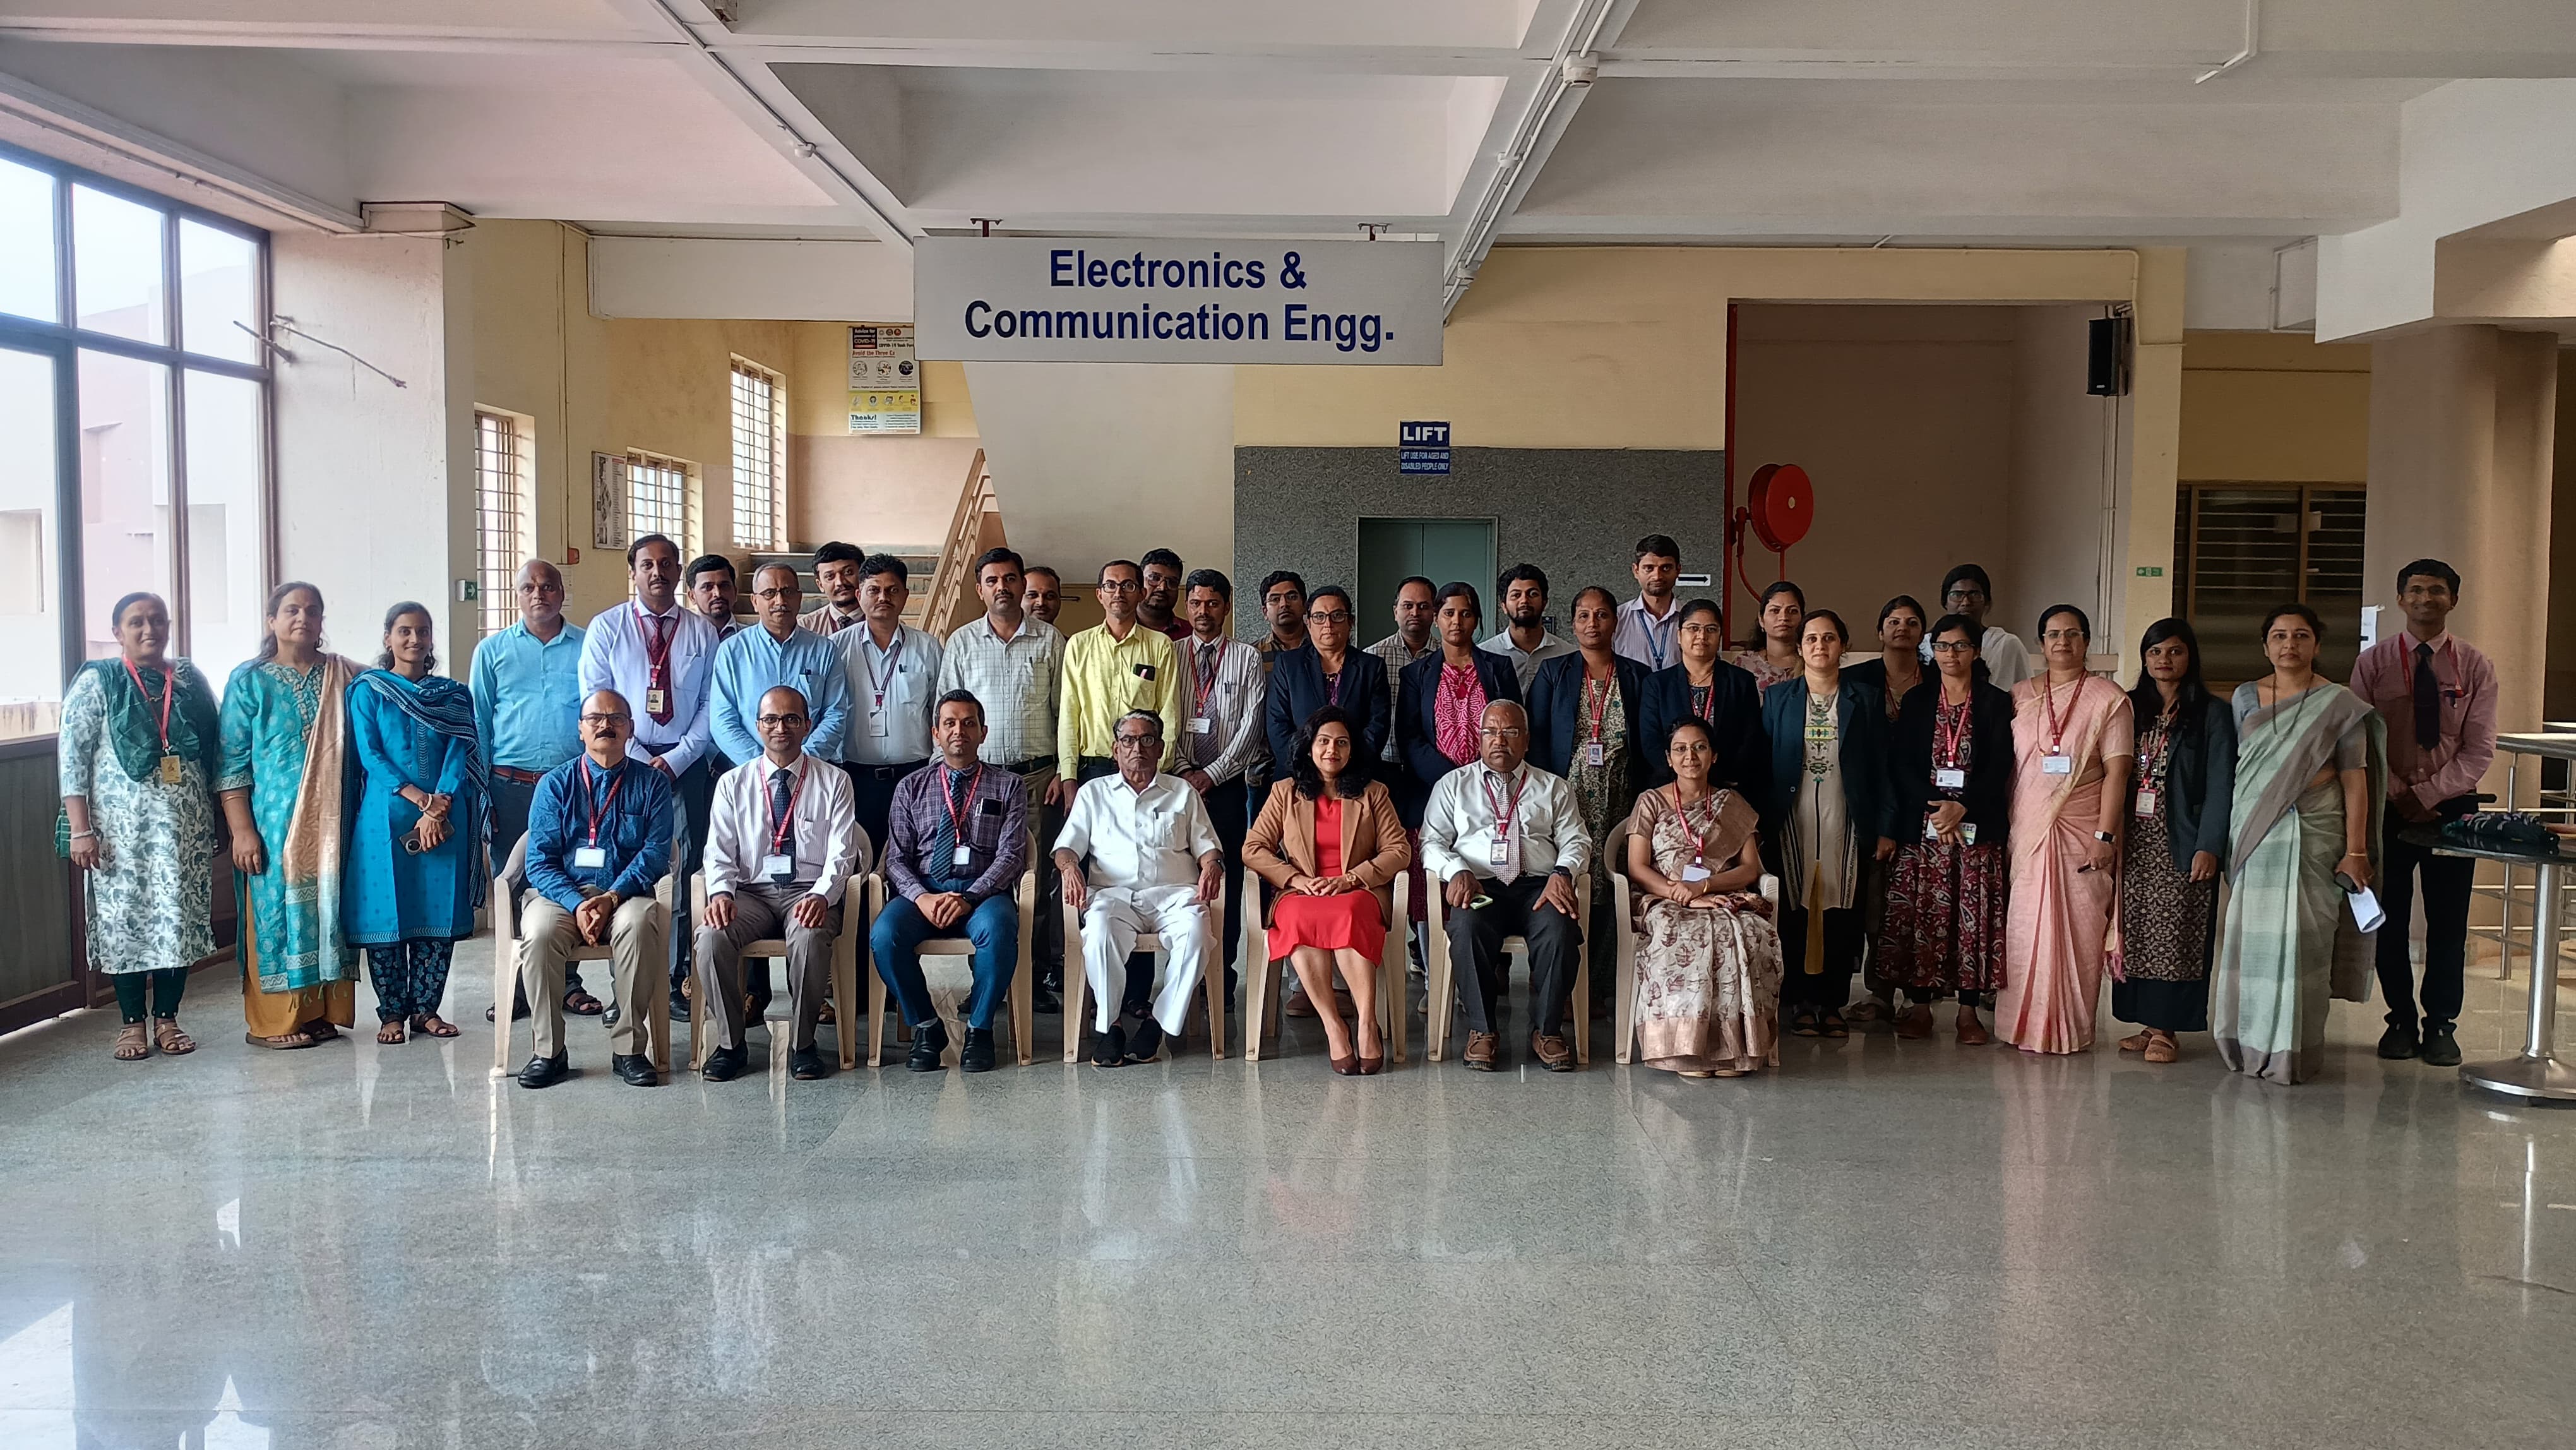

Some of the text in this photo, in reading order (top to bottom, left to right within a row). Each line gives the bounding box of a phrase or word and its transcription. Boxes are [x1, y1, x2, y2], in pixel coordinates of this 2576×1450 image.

[1050, 249, 1308, 290] Electronics &
[965, 300, 1394, 351] Communication Engg.
[1403, 426, 1447, 441] LIFT
[1401, 452, 1410, 460] LIFT
[1410, 452, 1419, 460] USE
[1419, 452, 1428, 460] FOR
